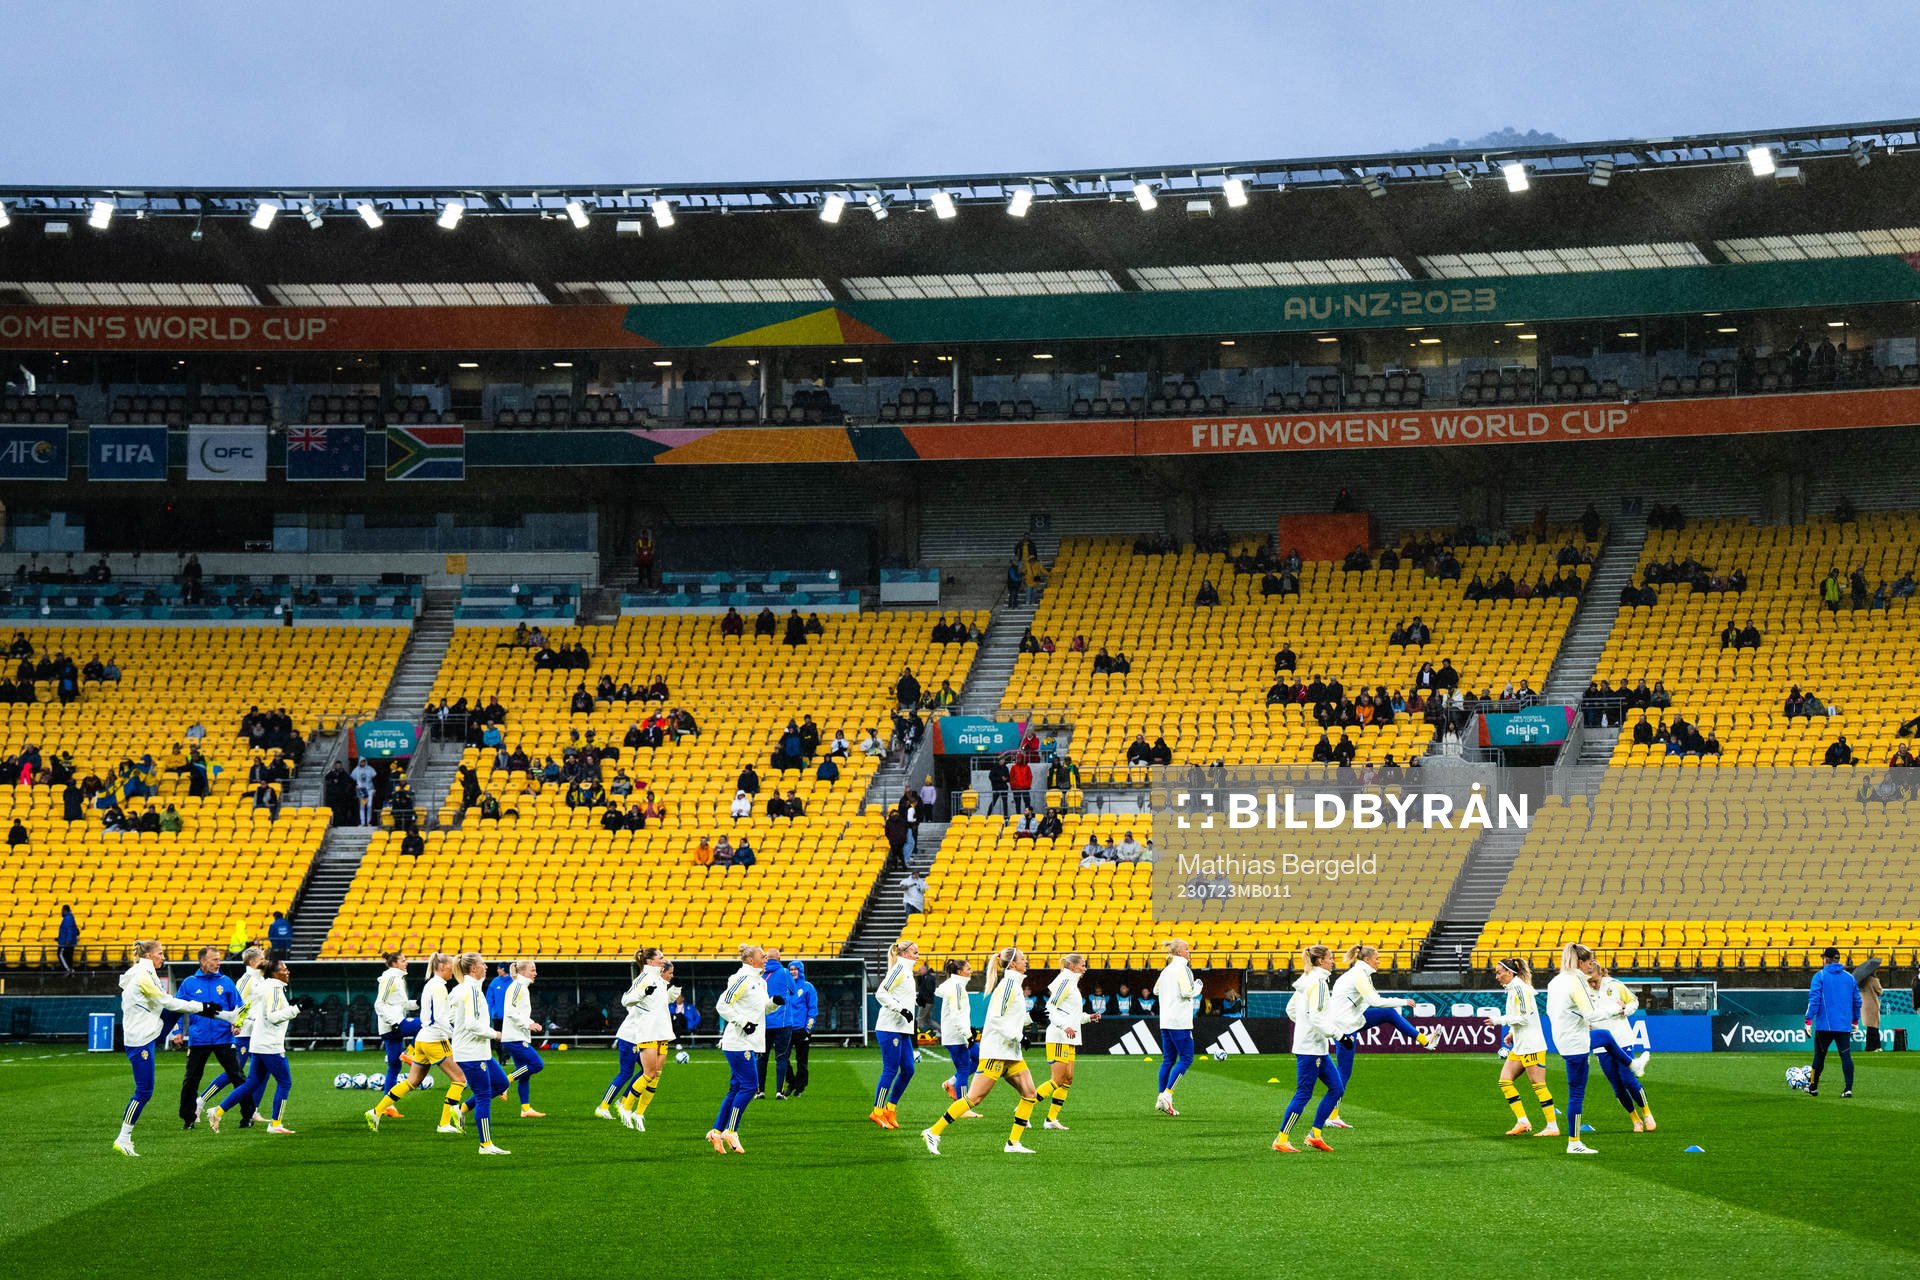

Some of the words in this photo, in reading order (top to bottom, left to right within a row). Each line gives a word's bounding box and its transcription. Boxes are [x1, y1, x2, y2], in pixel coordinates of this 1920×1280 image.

[134, 316, 250, 340] WORLD
[1191, 423, 1259, 448] FIFA
[1264, 417, 1421, 445] WOMEN'S
[1431, 412, 1550, 440] WORLD
[101, 444, 155, 463] FIFA
[214, 447, 254, 459] OFC
[1035, 515, 1045, 528] 8
[1505, 724, 1538, 734] Aisle
[1541, 724, 1550, 734] 7
[364, 738, 396, 749] Aisle
[399, 738, 409, 749] 9
[958, 733, 991, 744] Aisle
[993, 734, 1003, 744] 8
[1741, 1025, 1806, 1043] Rexona
